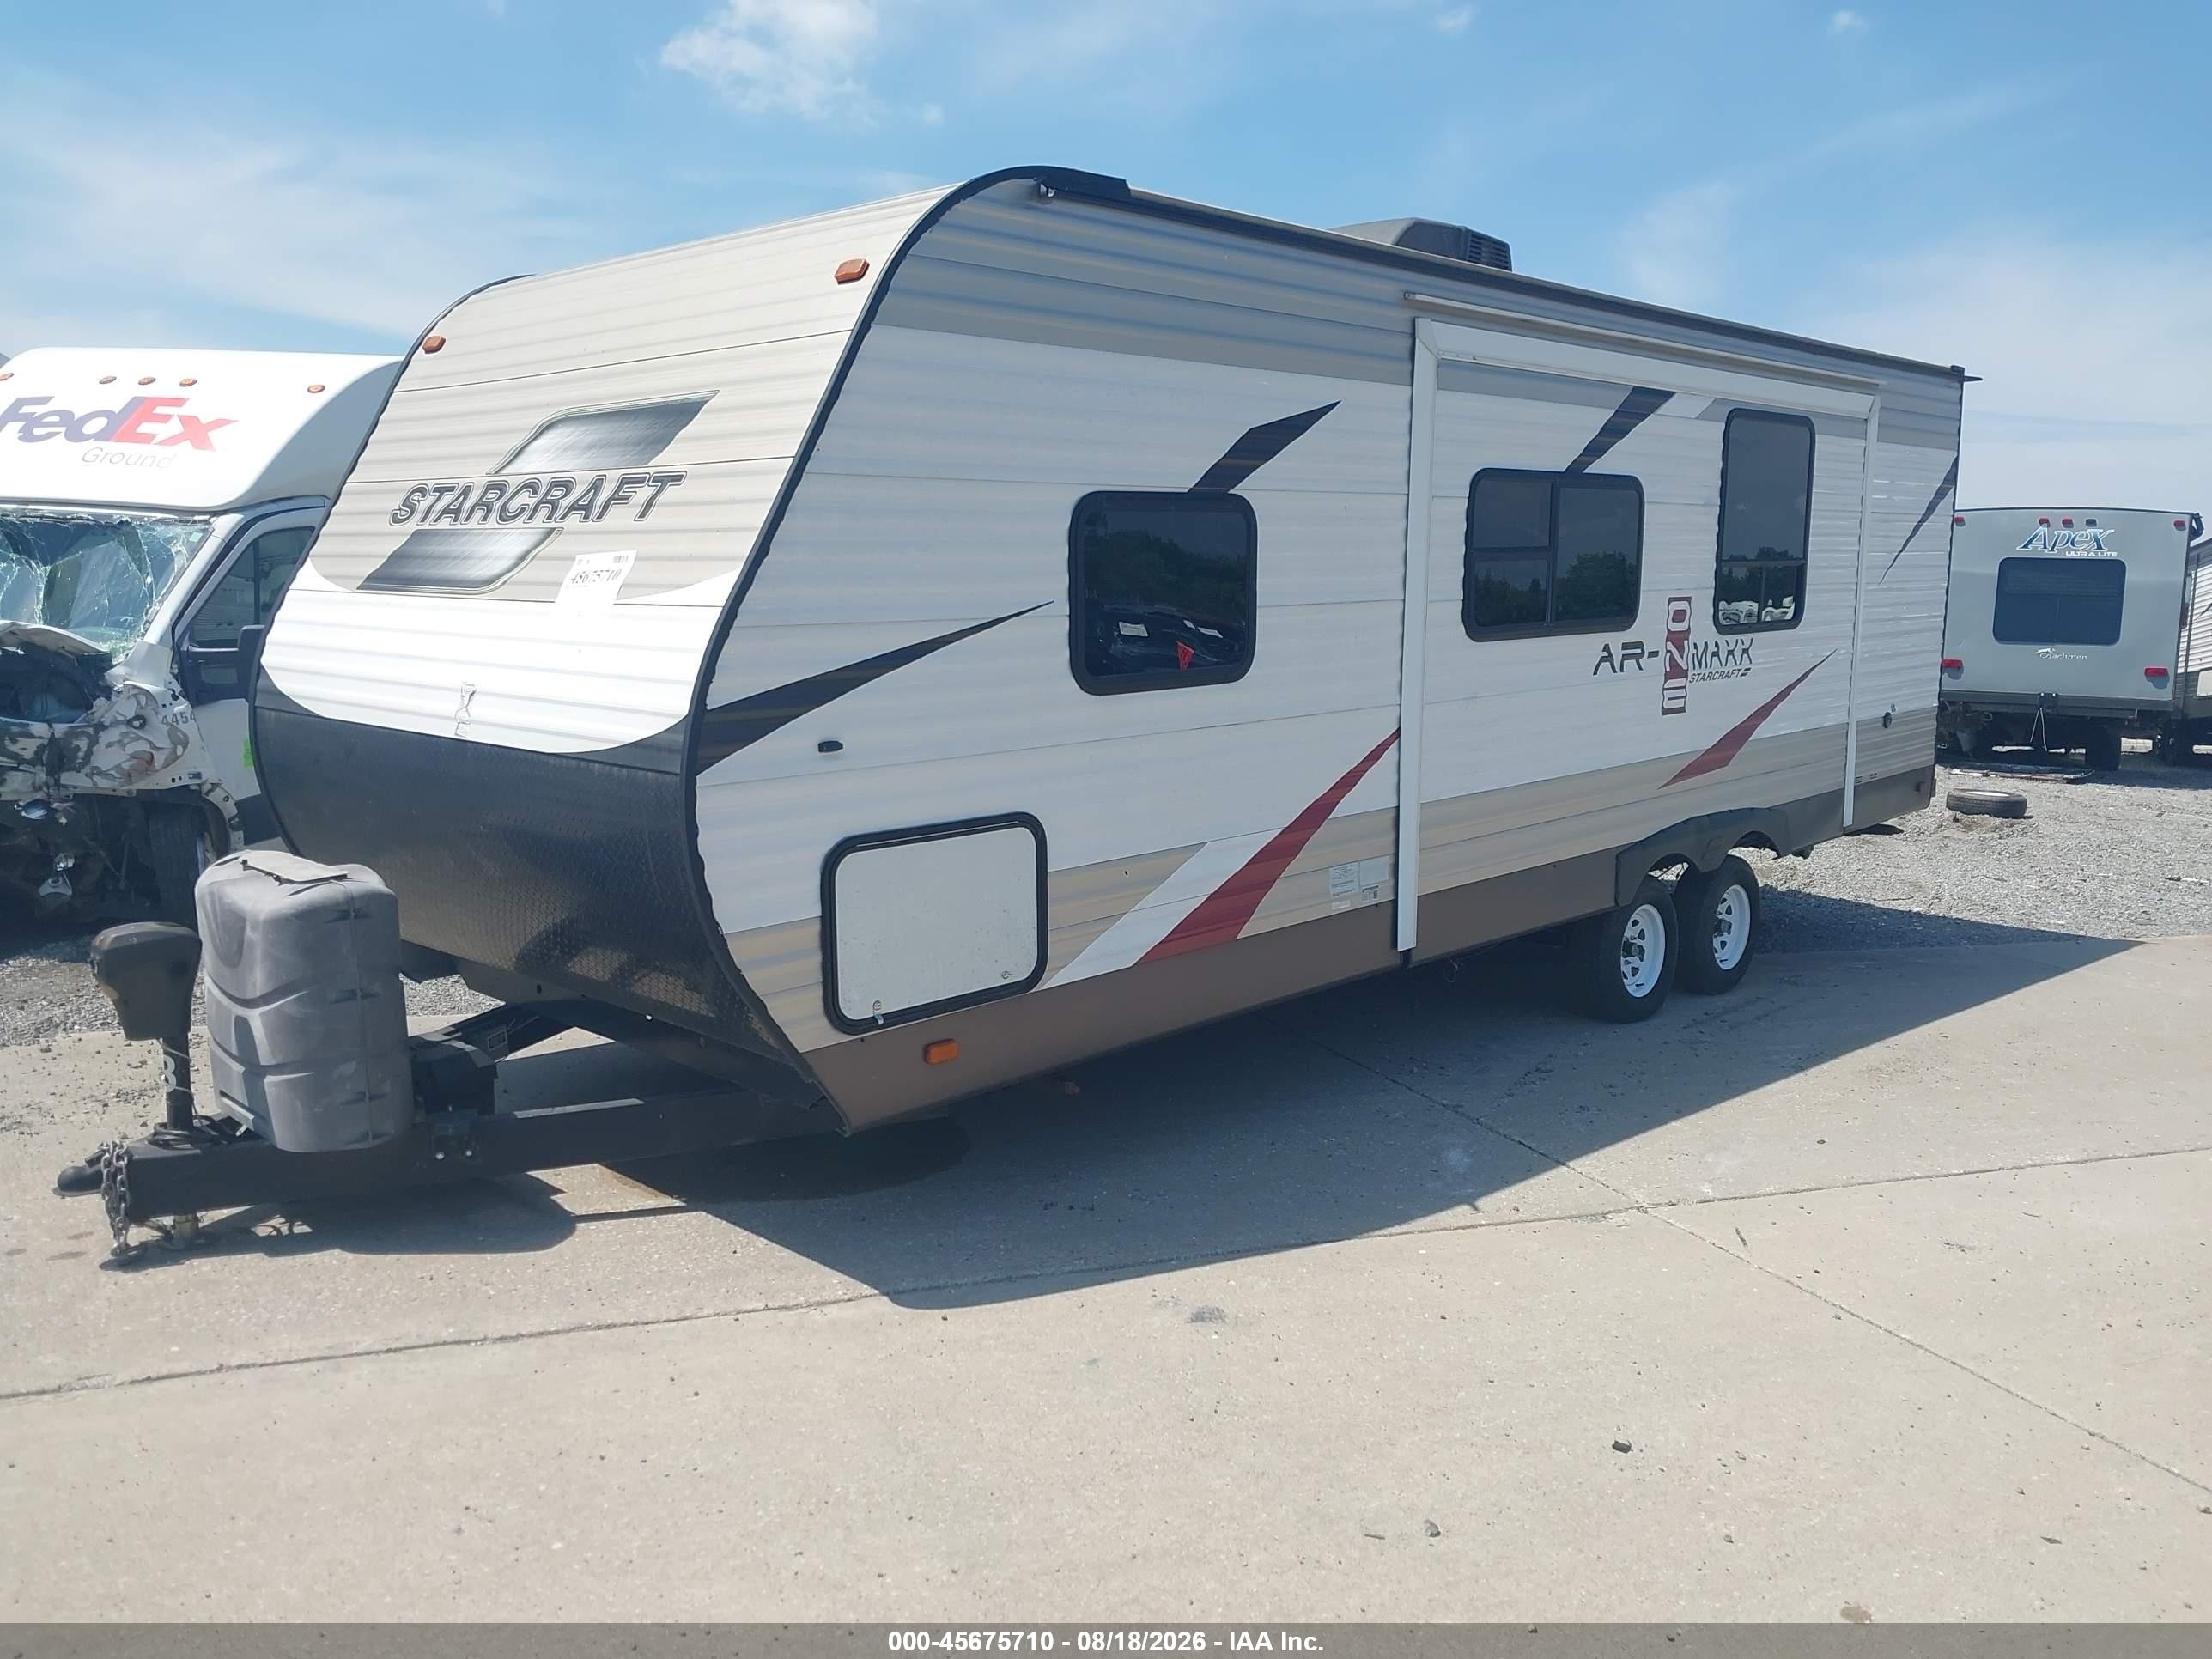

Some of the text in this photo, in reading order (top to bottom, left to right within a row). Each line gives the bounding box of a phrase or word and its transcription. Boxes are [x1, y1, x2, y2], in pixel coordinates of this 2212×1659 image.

[0, 396, 240, 451] FedEx
[82, 447, 179, 469] Ground
[389, 470, 687, 526] STARCRAFT
[2016, 526, 2115, 554] Apex
[1692, 638, 1753, 671] MAXX
[1689, 668, 1742, 684] STARCRAFT
